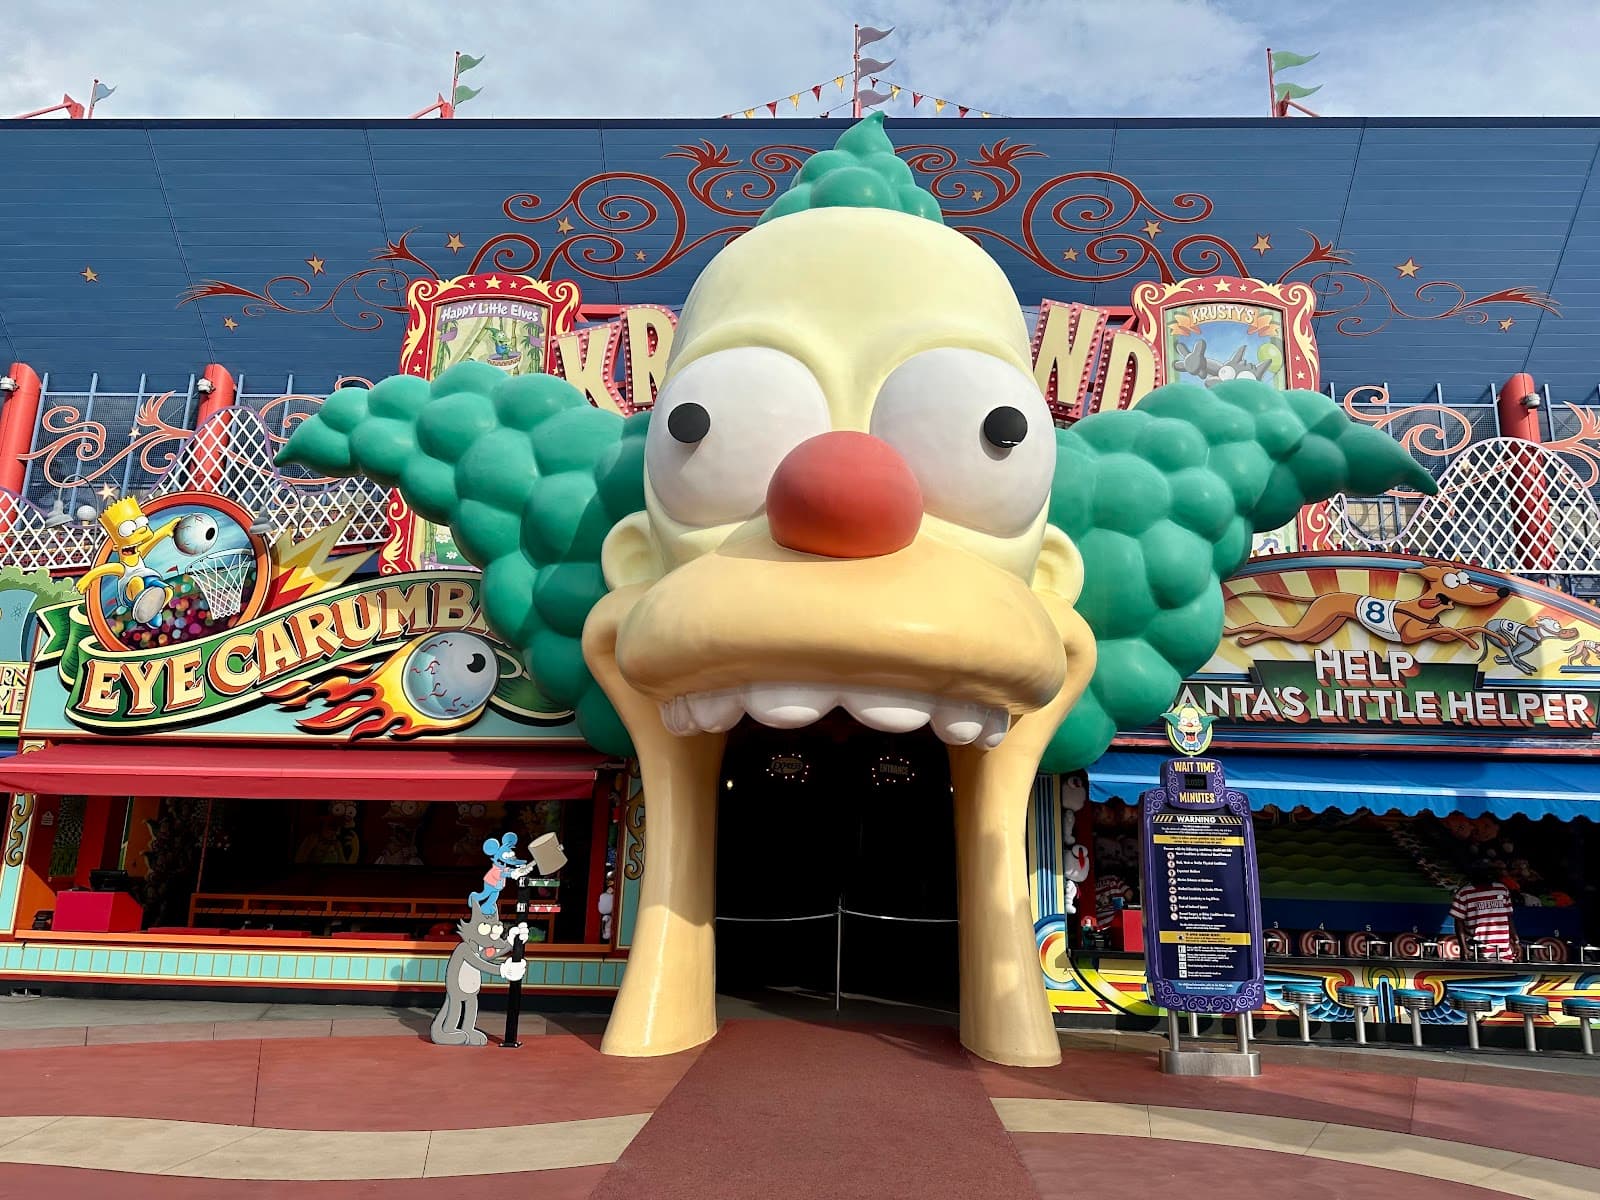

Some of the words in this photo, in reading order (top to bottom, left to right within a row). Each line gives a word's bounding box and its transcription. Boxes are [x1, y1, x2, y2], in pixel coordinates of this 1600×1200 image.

[478, 302, 508, 315] Little
[510, 305, 539, 322] Elves
[1191, 305, 1255, 324] KRUSTY'S
[1365, 600, 1385, 624] 8
[1507, 622, 1514, 632] 9
[1314, 649, 1416, 684] HELP
[76, 651, 204, 716] EYE
[1167, 685, 1306, 719] ANTA'S
[1315, 688, 1436, 720] LITTLE
[1449, 690, 1591, 724] HELPER
[1173, 761, 1194, 772] WAIT
[1195, 762, 1216, 773] TIME
[1179, 792, 1216, 803] MINUTES
[1176, 815, 1217, 824] WARNING
[1273, 921, 1279, 929] 3
[1319, 922, 1325, 930] 4
[1365, 924, 1371, 932] 5
